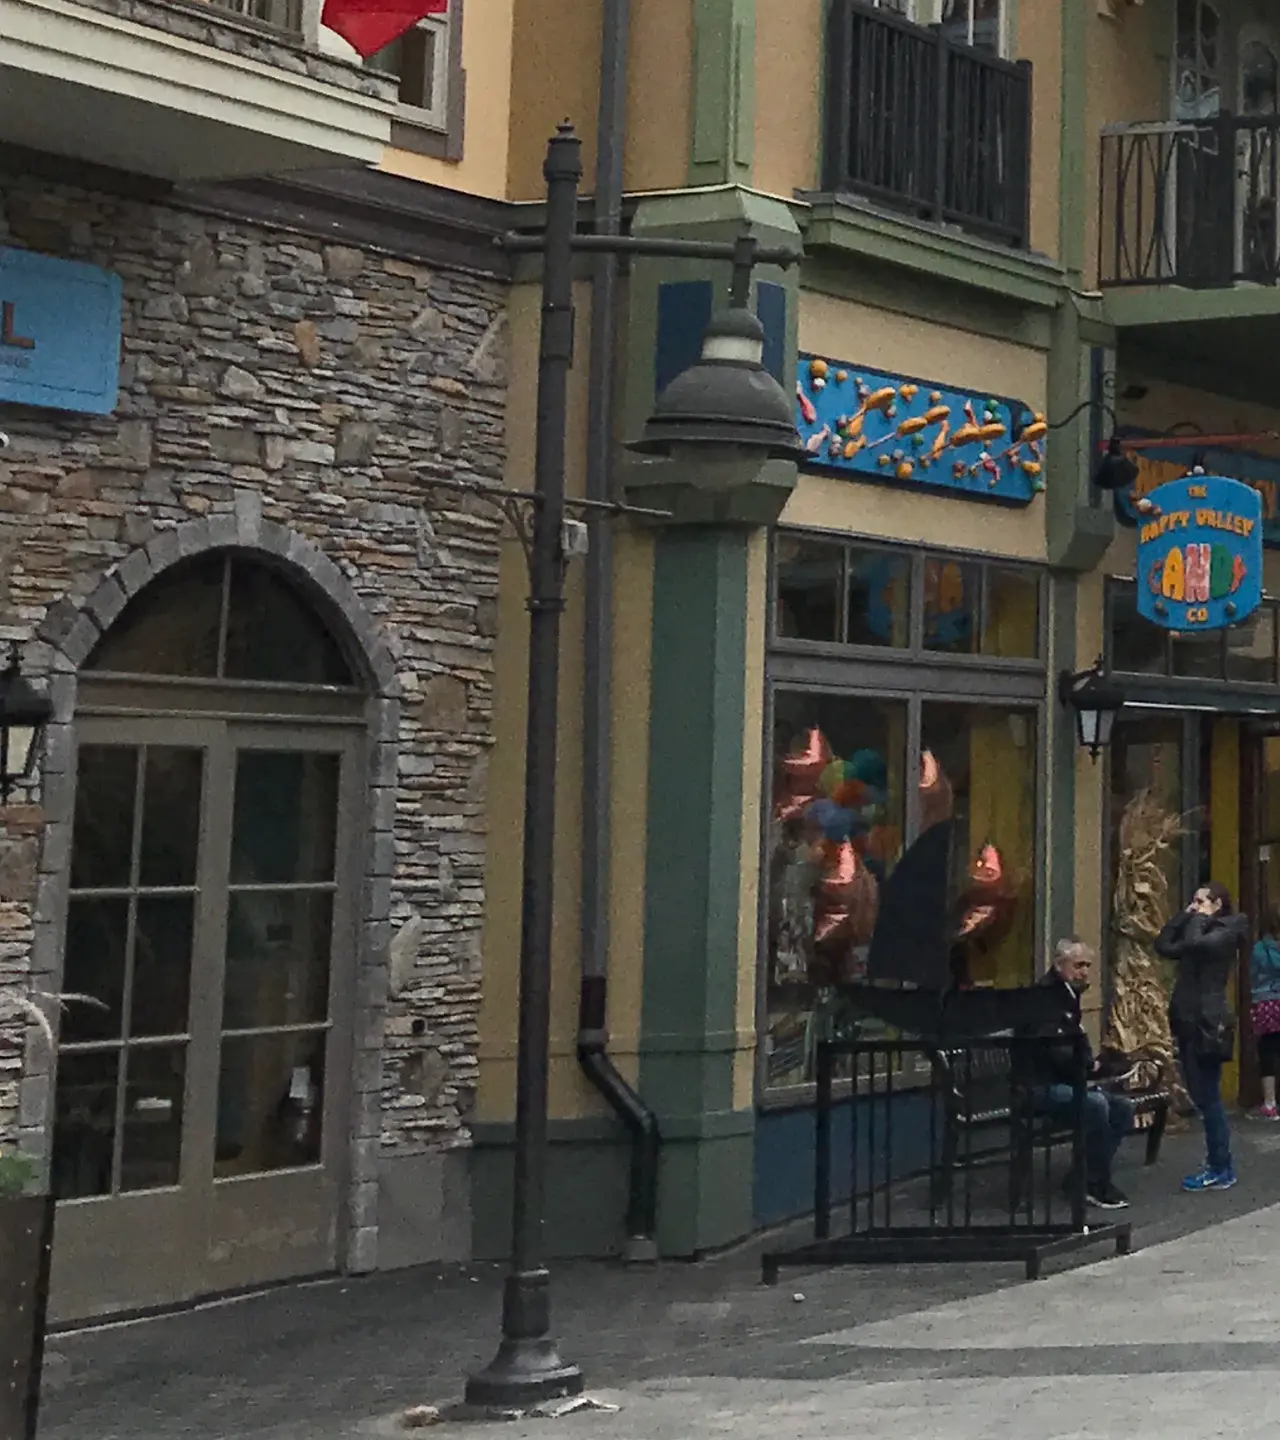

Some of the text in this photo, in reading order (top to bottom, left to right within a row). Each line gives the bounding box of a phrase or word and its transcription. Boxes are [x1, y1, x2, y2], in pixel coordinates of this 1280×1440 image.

[1140, 508, 1255, 544] HAPPY VALLEY
[1149, 543, 1247, 603] CANDY
[1186, 607, 1209, 623] CO
